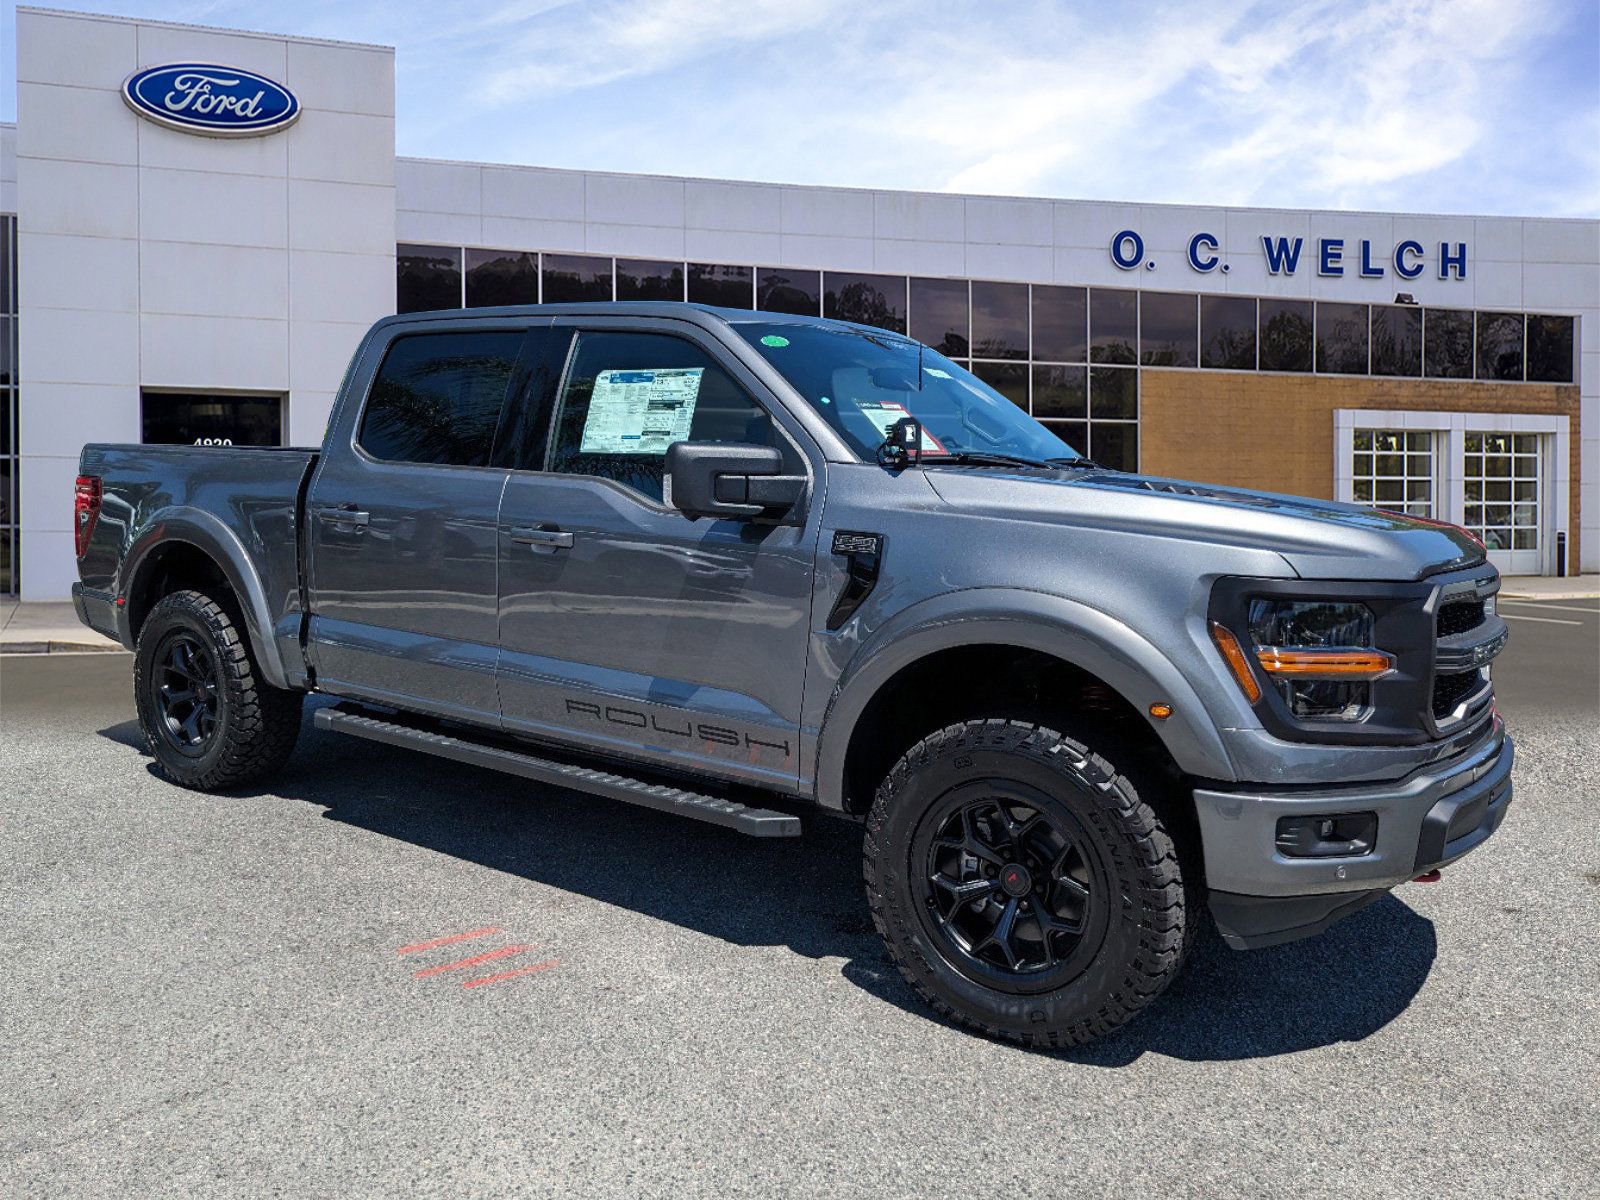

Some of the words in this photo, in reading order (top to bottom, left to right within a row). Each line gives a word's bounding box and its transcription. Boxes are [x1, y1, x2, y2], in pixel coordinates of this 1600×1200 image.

[164, 73, 265, 118] Ford
[1110, 230, 1156, 271] O.
[1187, 232, 1231, 274] C.
[1260, 235, 1467, 281] WELCH
[565, 699, 790, 757] ROUSH
